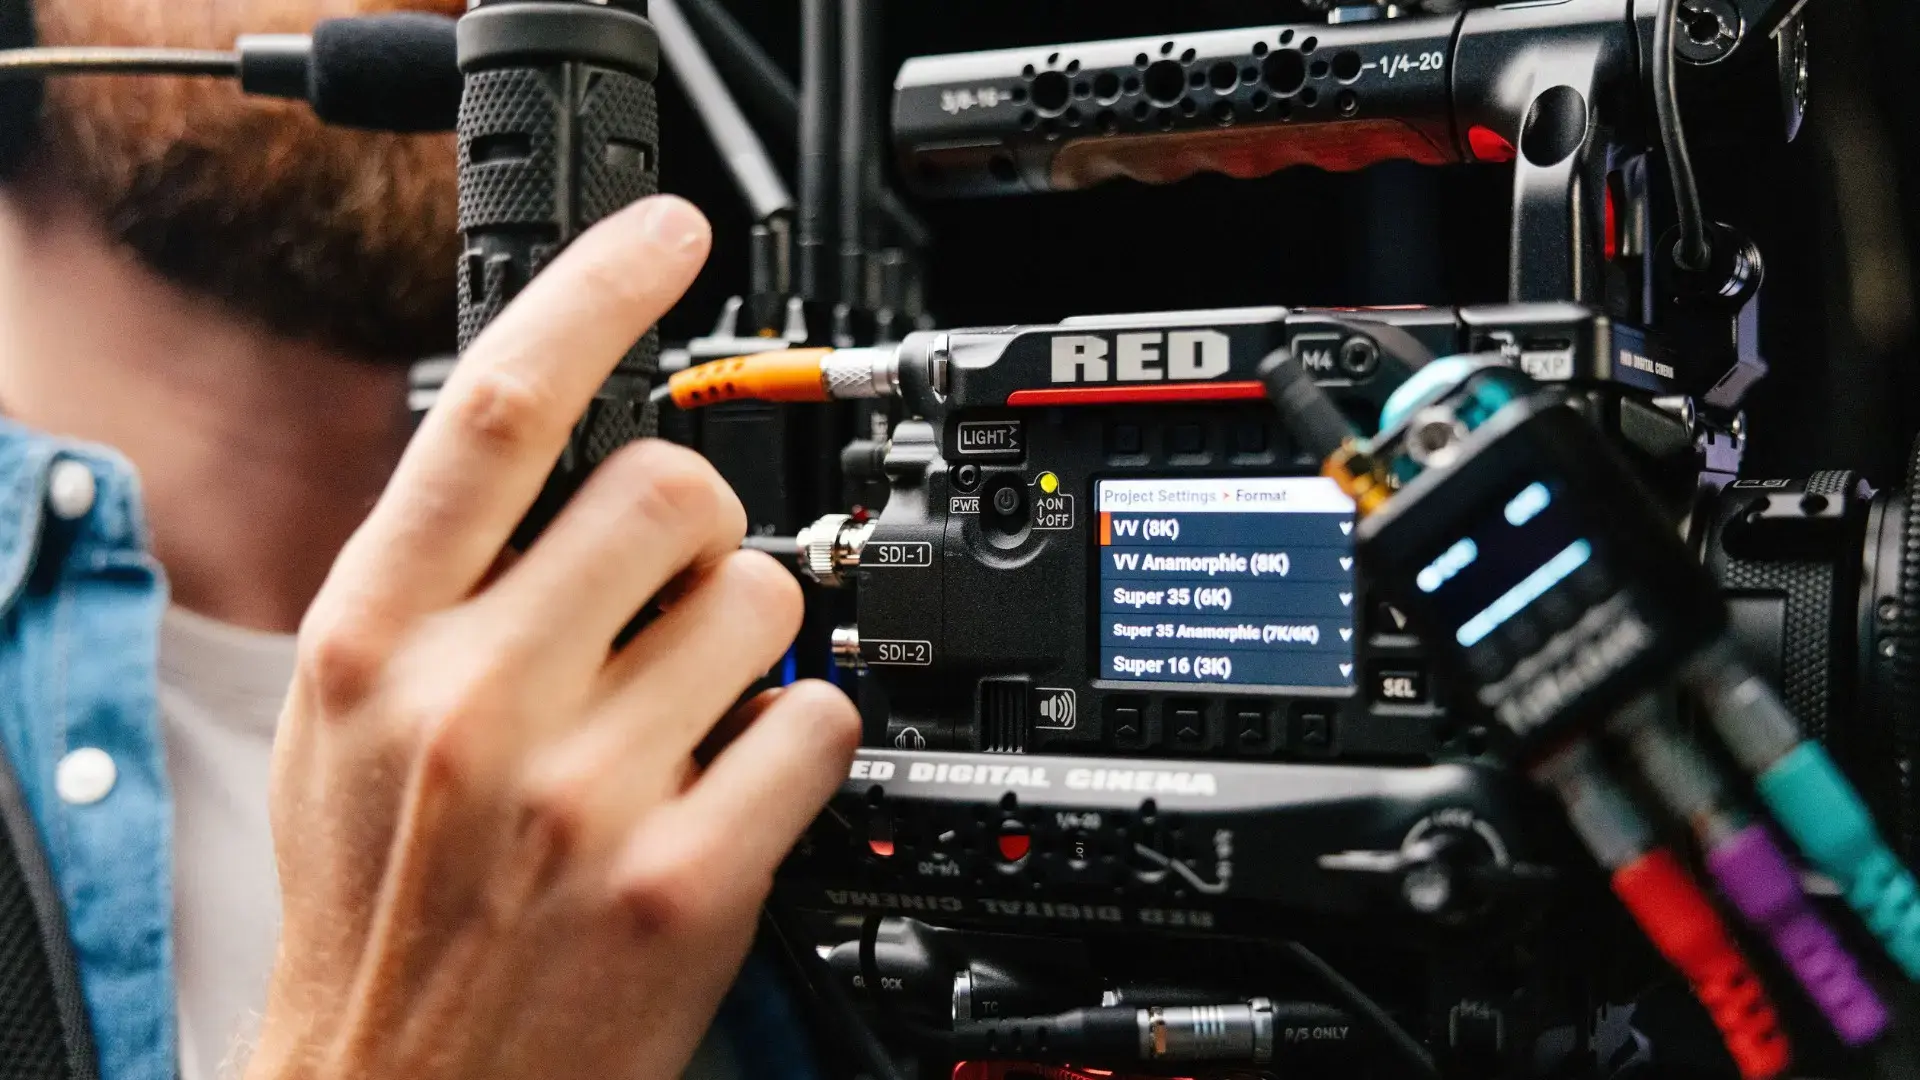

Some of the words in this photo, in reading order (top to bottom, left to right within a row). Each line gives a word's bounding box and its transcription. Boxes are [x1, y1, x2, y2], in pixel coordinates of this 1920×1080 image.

[1380, 51, 1443, 78] 1/4-20
[1051, 330, 1230, 383] RED
[1302, 348, 1333, 371] M4
[963, 429, 1007, 446] LIGHT
[951, 498, 980, 512] PWR
[1045, 498, 1064, 511] ON
[1104, 488, 1154, 506] Project
[1158, 488, 1217, 504] Settings
[1236, 488, 1289, 502] Format
[1045, 513, 1070, 527] OFF
[1113, 519, 1139, 537] VV
[1143, 518, 1180, 541] (8K)
[878, 545, 924, 564] SDI-1
[1113, 553, 1139, 571] VV
[1142, 552, 1248, 577] Anamorphic
[1250, 551, 1290, 577] (8K)
[1113, 587, 1164, 608] Super
[1167, 588, 1191, 606] 35
[1194, 586, 1233, 611] (6K)
[1113, 623, 1154, 640] Super
[1156, 623, 1175, 638] 35
[1176, 623, 1261, 643] Anamorphic
[878, 643, 926, 662] SDI-2
[1113, 655, 1164, 677] Super
[1167, 656, 1191, 674] 16
[1194, 656, 1233, 680] (3K)
[1382, 676, 1418, 699] SEL
[849, 759, 896, 781] ED
[908, 760, 1051, 789] DIGITAL
[1065, 767, 1218, 796] CINEMA
[825, 889, 964, 913] CINEMA
[977, 898, 1123, 923] DIGITAL
[982, 1000, 999, 1014] TC
[1312, 1026, 1350, 1041] ONLY
